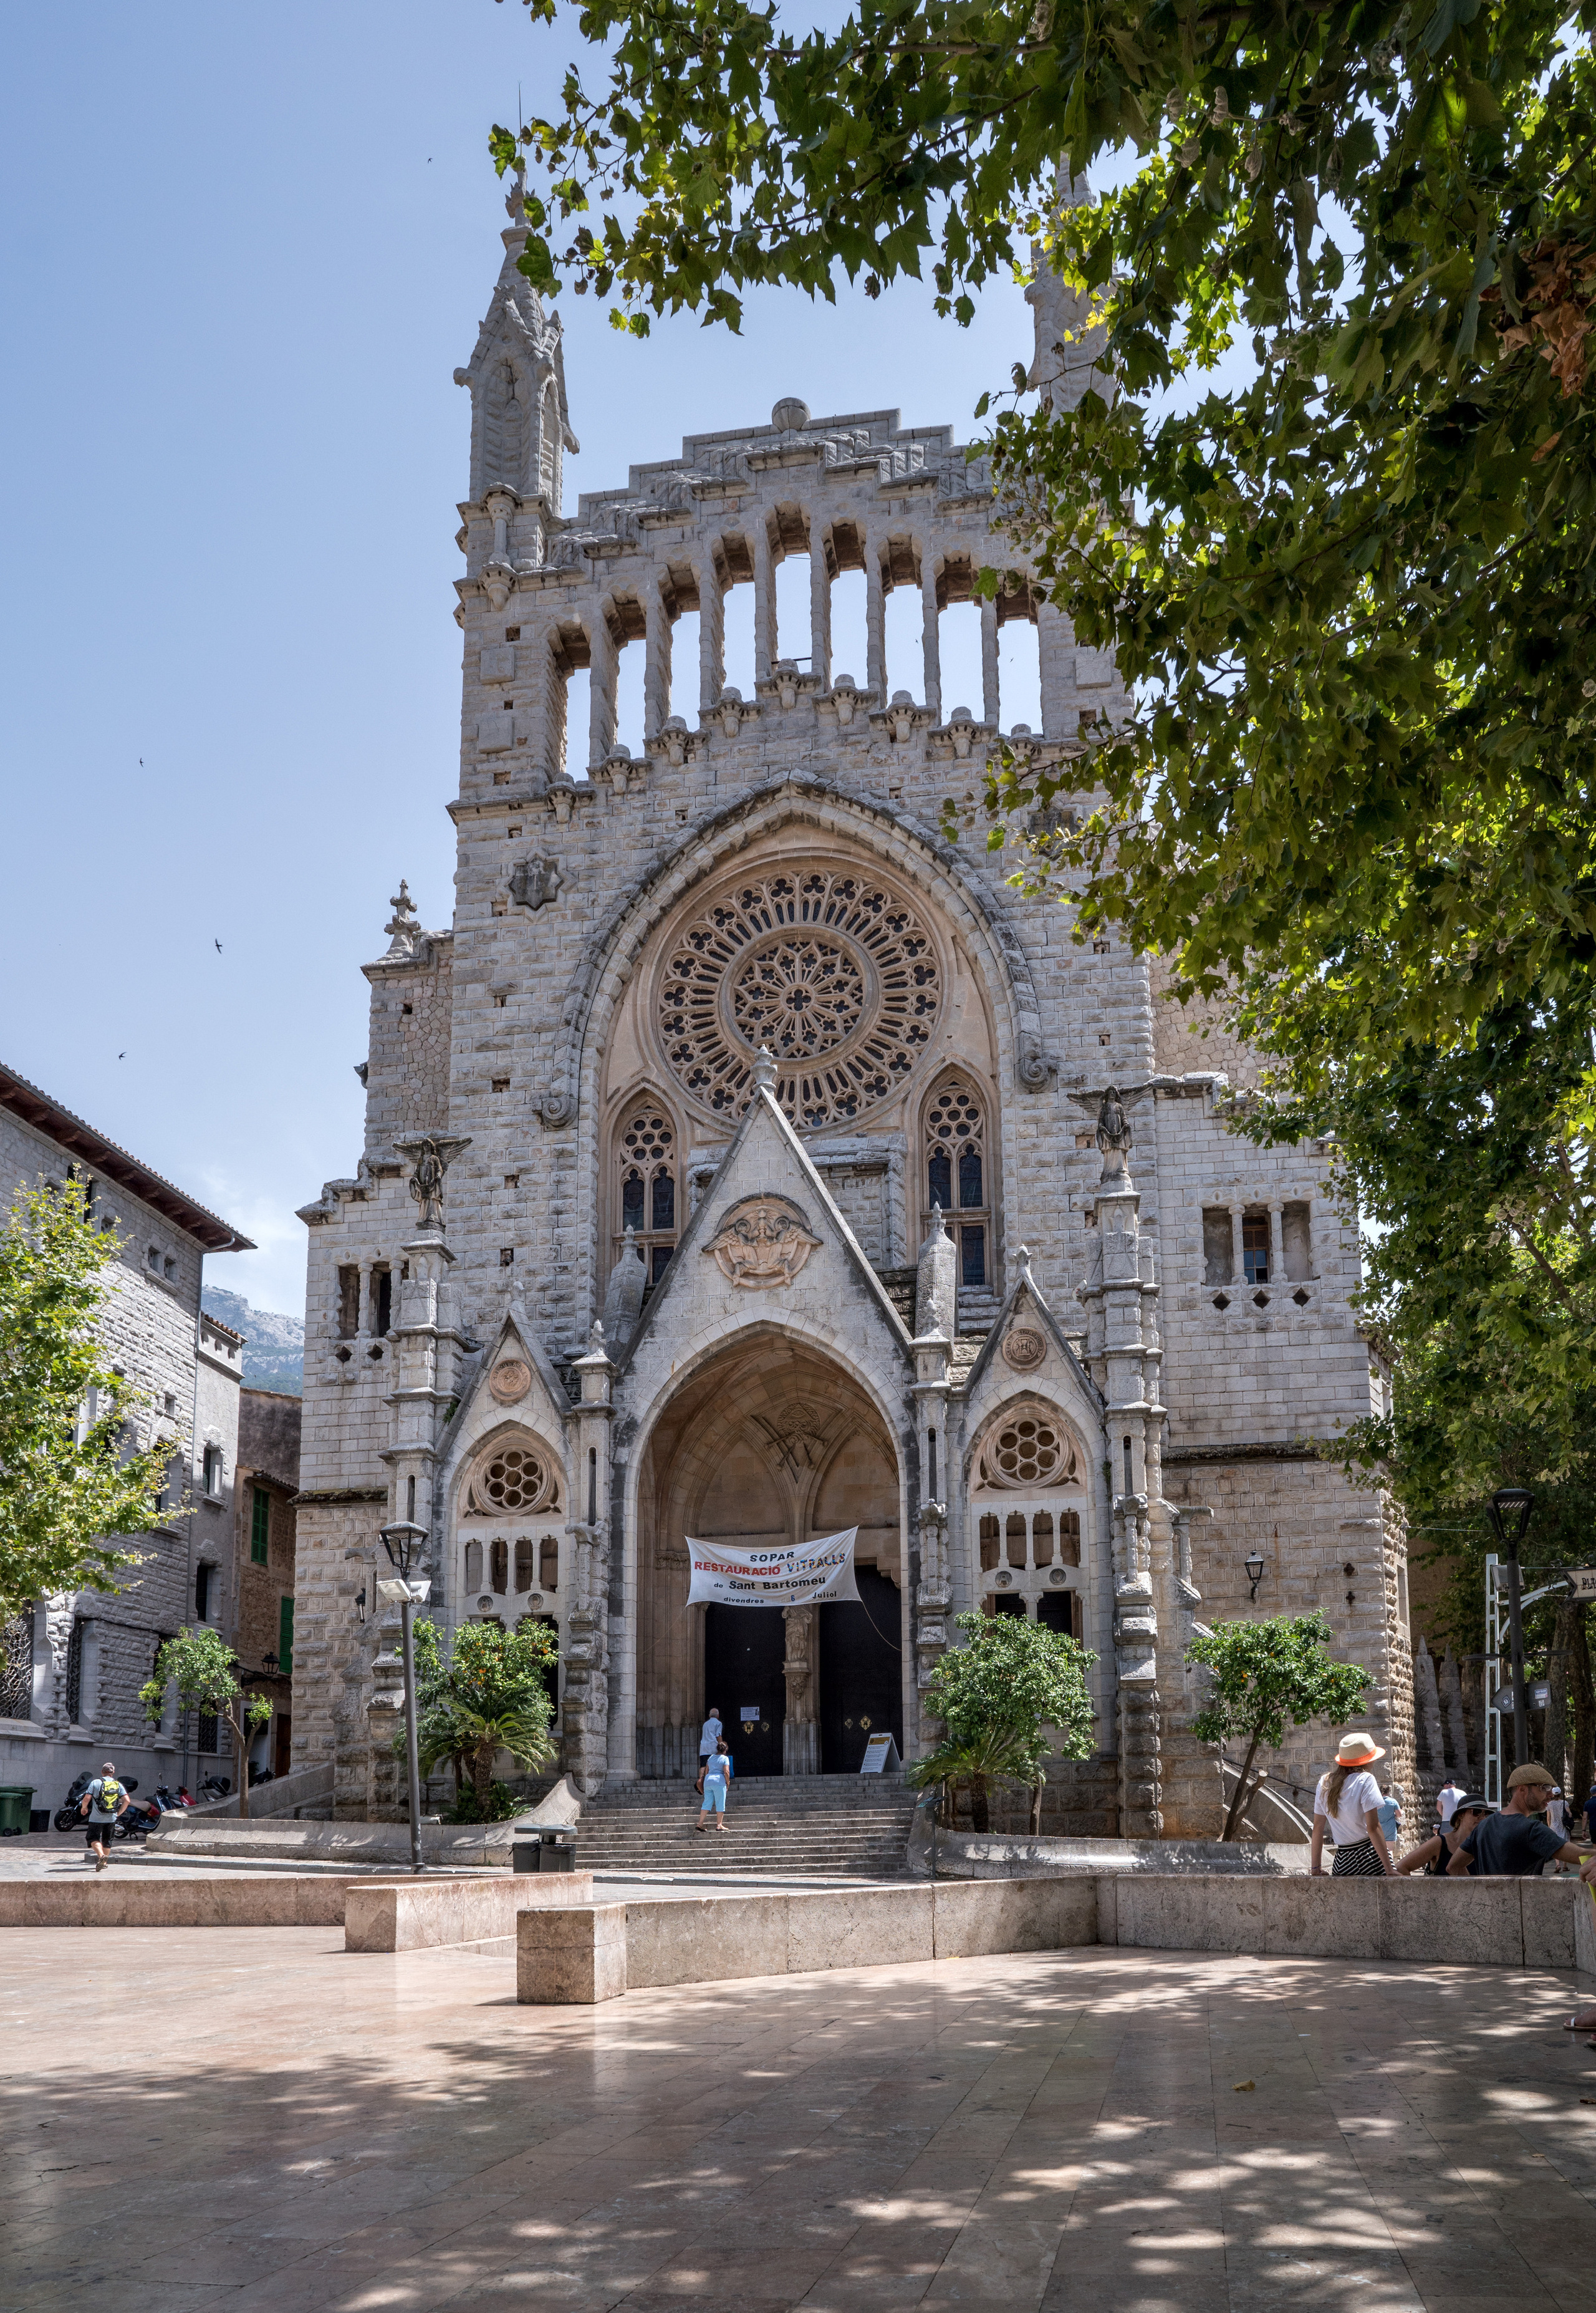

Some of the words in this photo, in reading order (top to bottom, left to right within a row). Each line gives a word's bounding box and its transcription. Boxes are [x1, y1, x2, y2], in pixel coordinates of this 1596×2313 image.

[750, 1552, 794, 1562] SOPAR
[787, 1553, 845, 1573] VITRALLS
[729, 1580, 756, 1590] Sant
[762, 1577, 826, 1590] Bartomeu
[812, 1591, 837, 1599] Juliol
